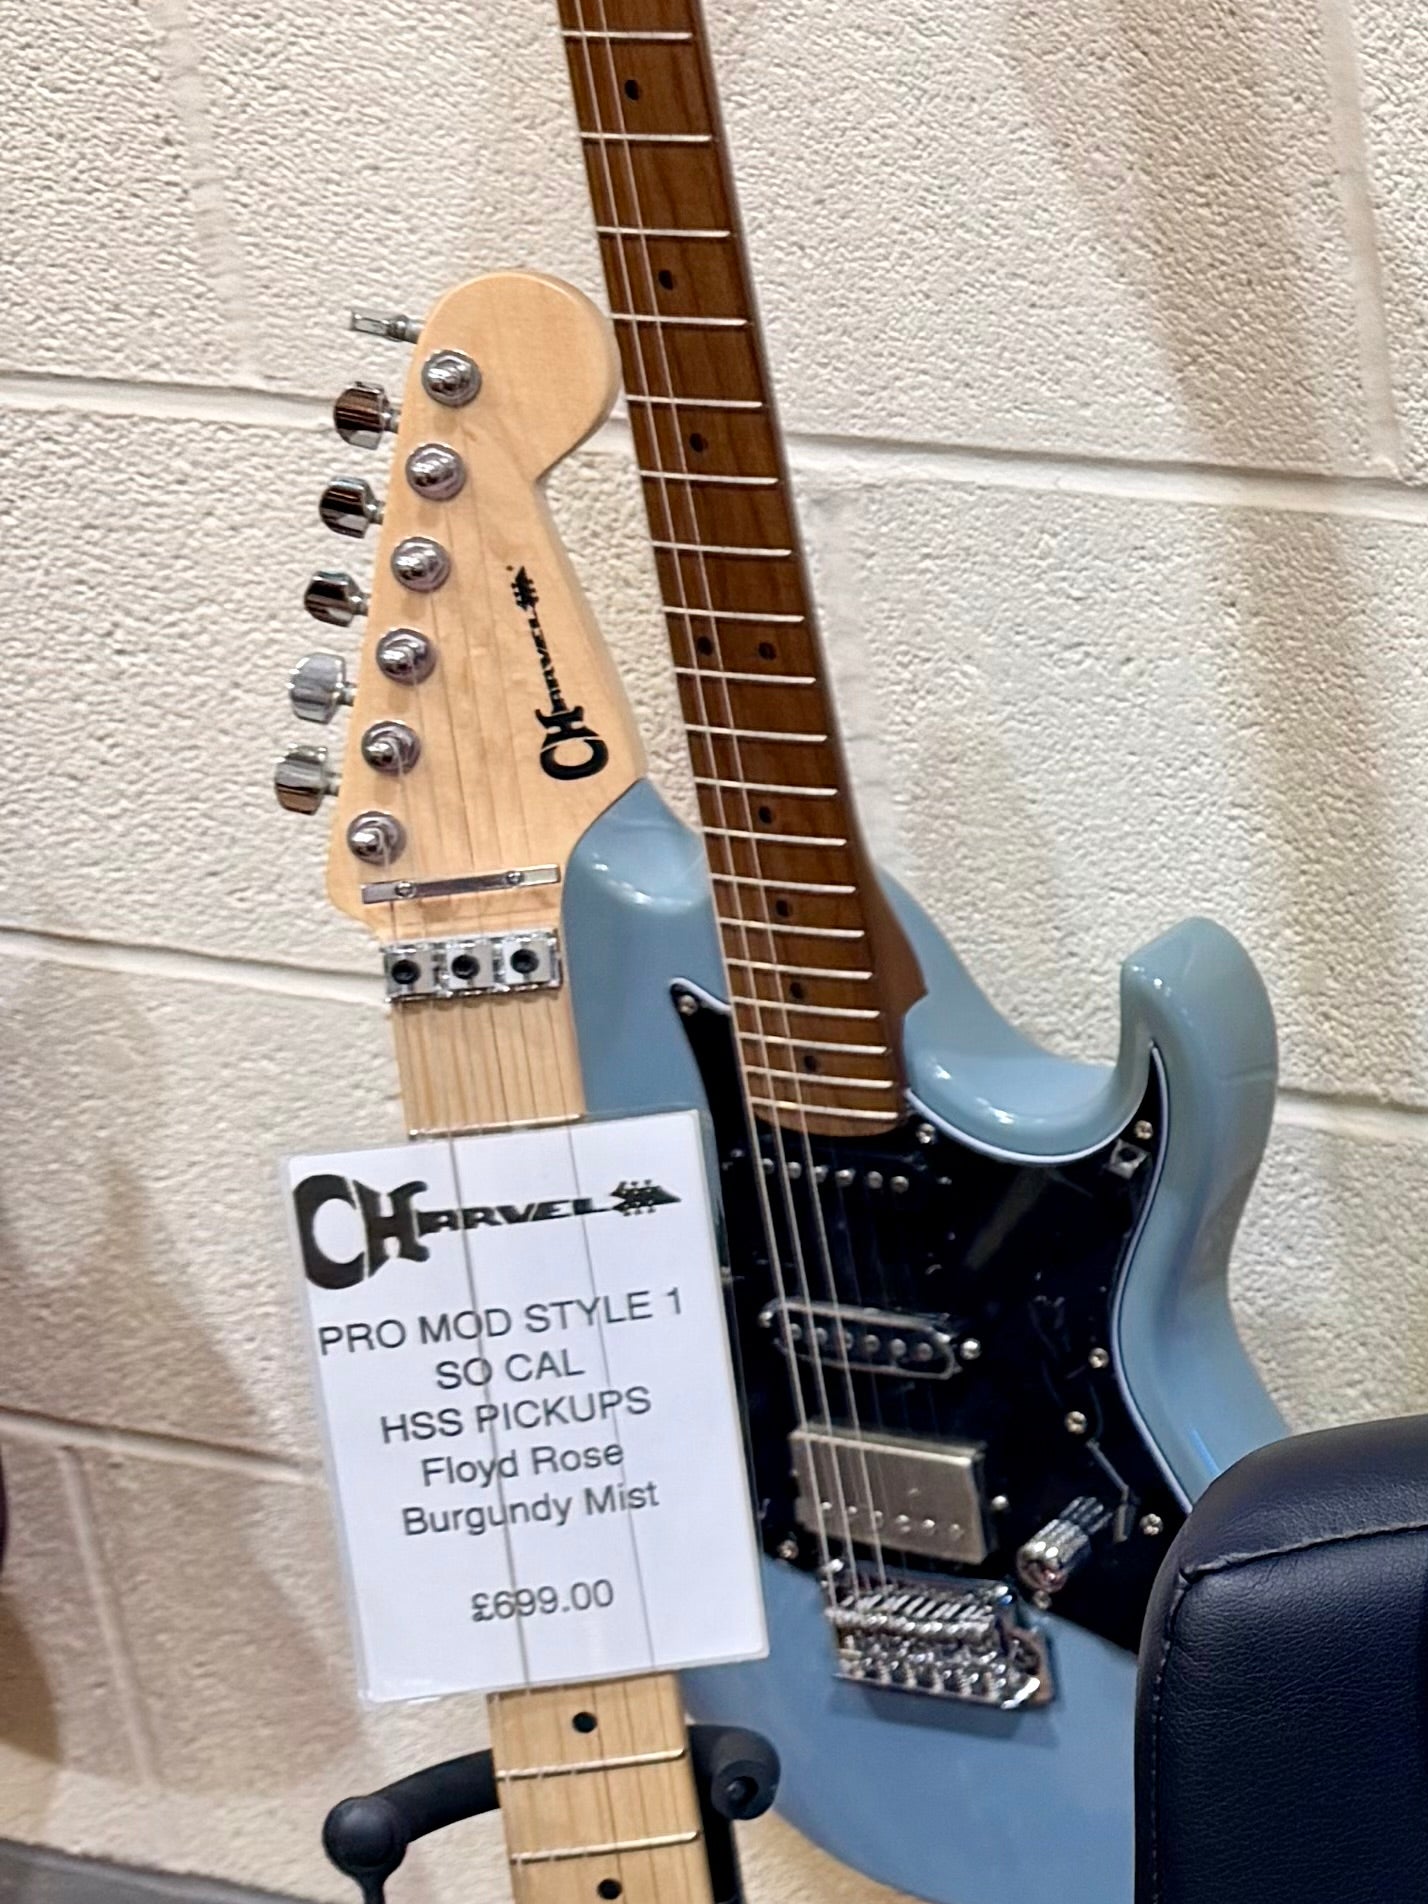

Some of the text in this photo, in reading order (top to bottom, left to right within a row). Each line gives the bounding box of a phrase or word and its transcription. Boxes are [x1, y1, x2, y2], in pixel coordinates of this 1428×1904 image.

[319, 1287, 683, 1356] PRO MOD STYLE 1
[435, 1347, 586, 1391] SO CAL
[381, 1386, 652, 1445] HSS PICKUPS
[422, 1442, 625, 1489] Floyd Rose
[402, 1480, 660, 1537] Burgundy Mist
[470, 1579, 615, 1624] £699.00
